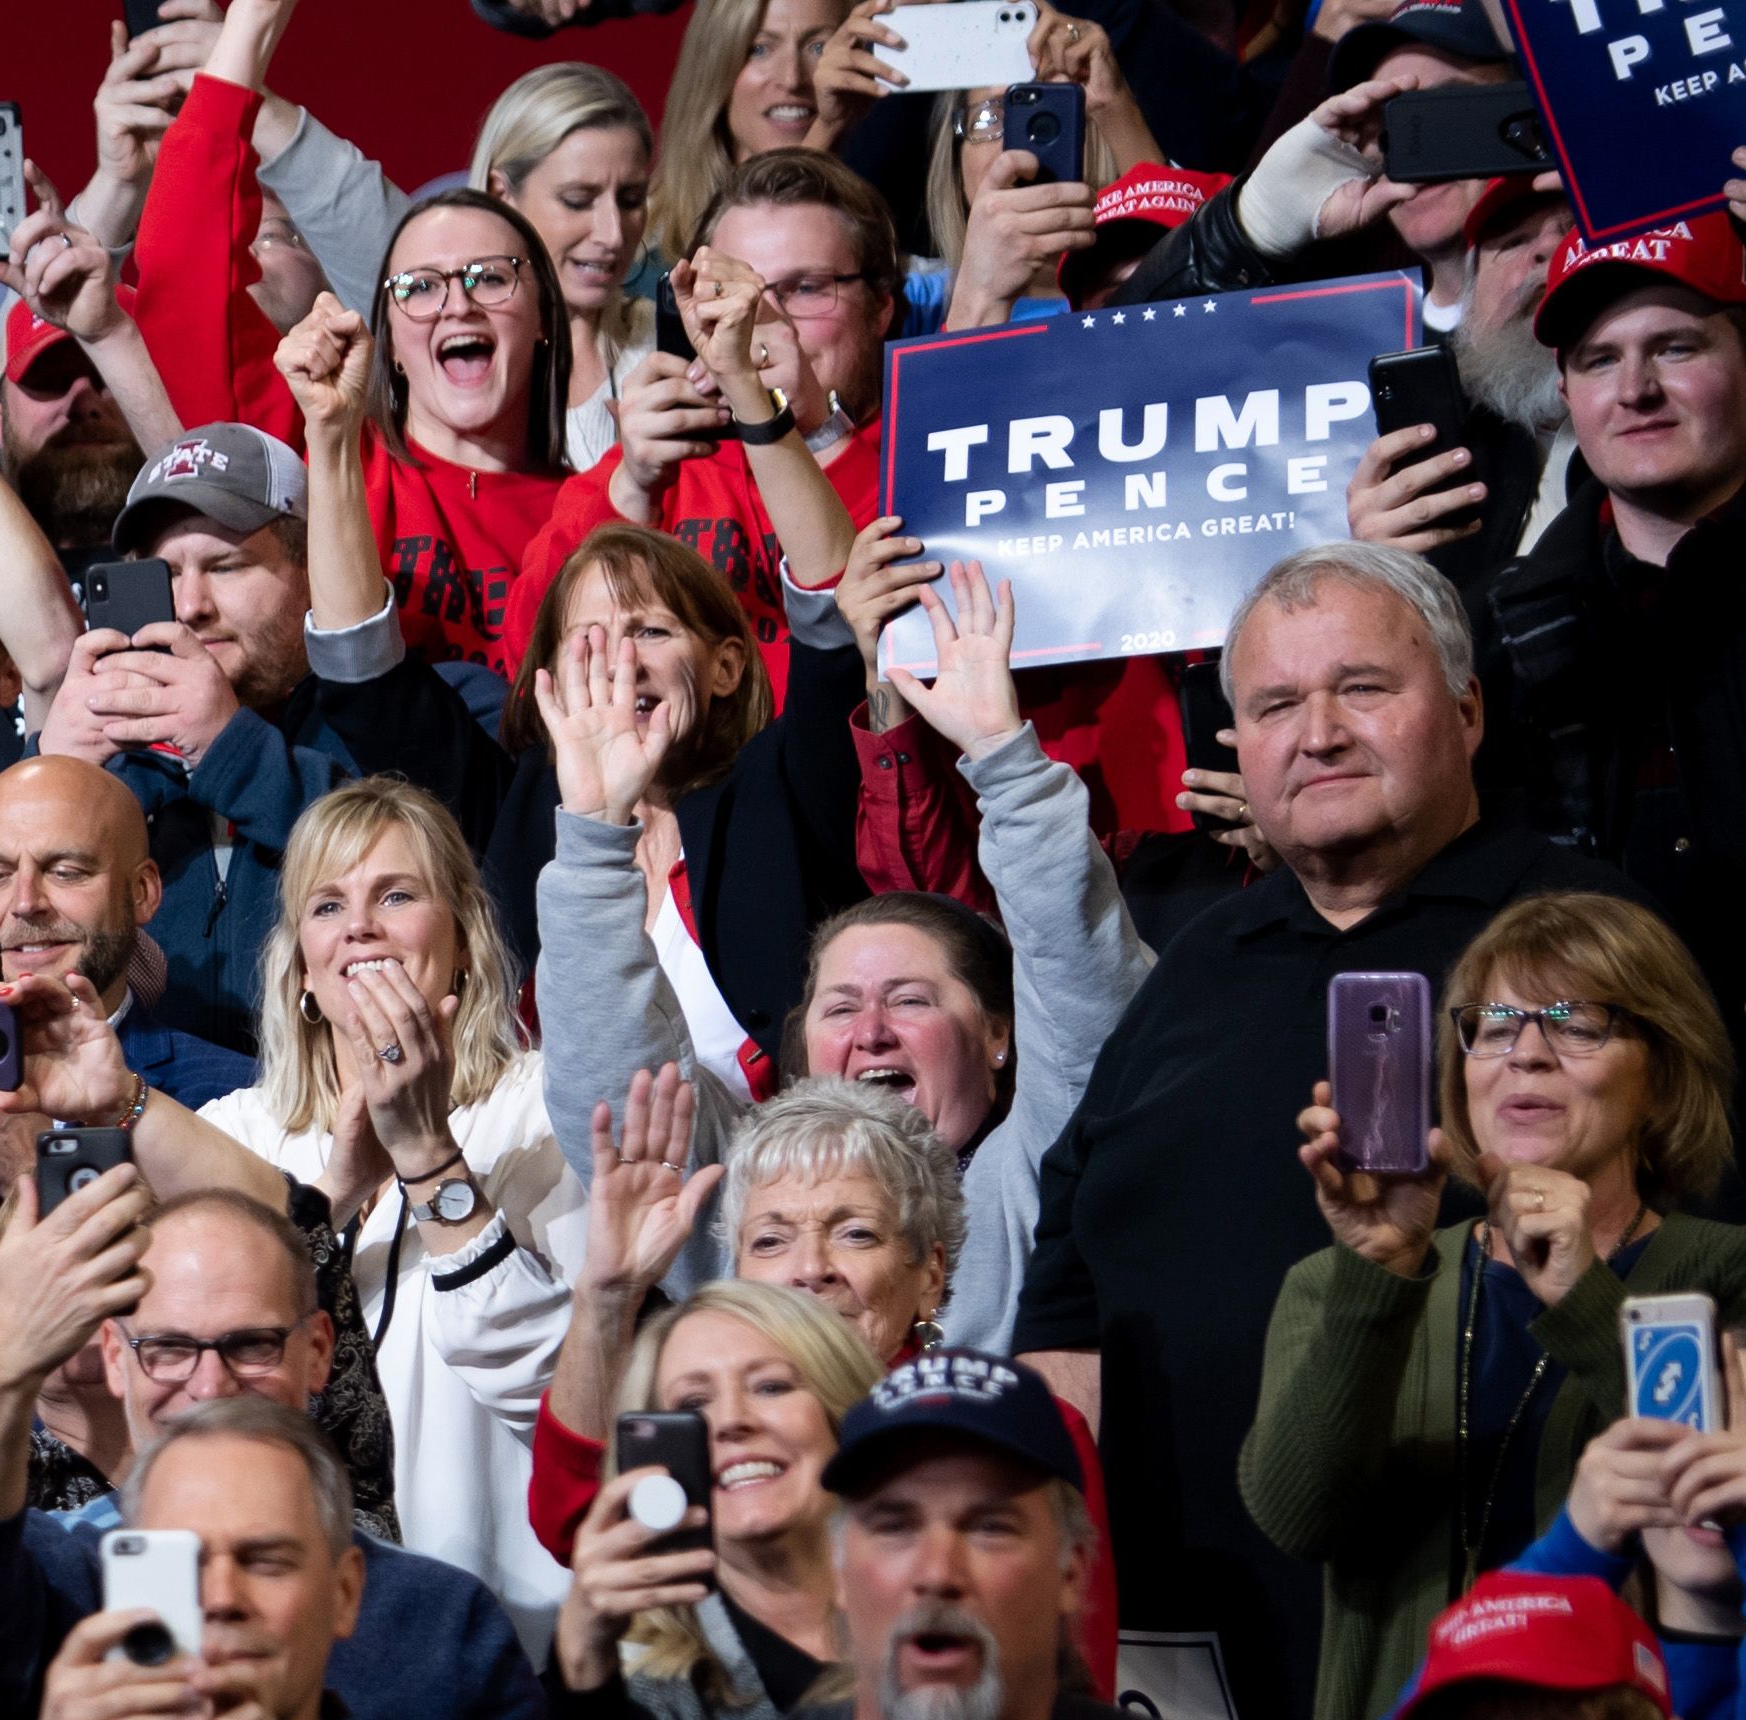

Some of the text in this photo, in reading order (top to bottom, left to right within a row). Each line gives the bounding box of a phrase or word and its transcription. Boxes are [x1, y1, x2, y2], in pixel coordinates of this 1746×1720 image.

[1654, 71, 1719, 106] KEEP
[1092, 180, 1205, 214] AKE AMERICA
[1138, 196, 1196, 213] AGAIN
[927, 380, 1373, 483] TRUMP
[965, 455, 1328, 528] PENCE
[997, 511, 1296, 558] KEEP AMERICA GREAT!
[1120, 629, 1177, 652] 2020
